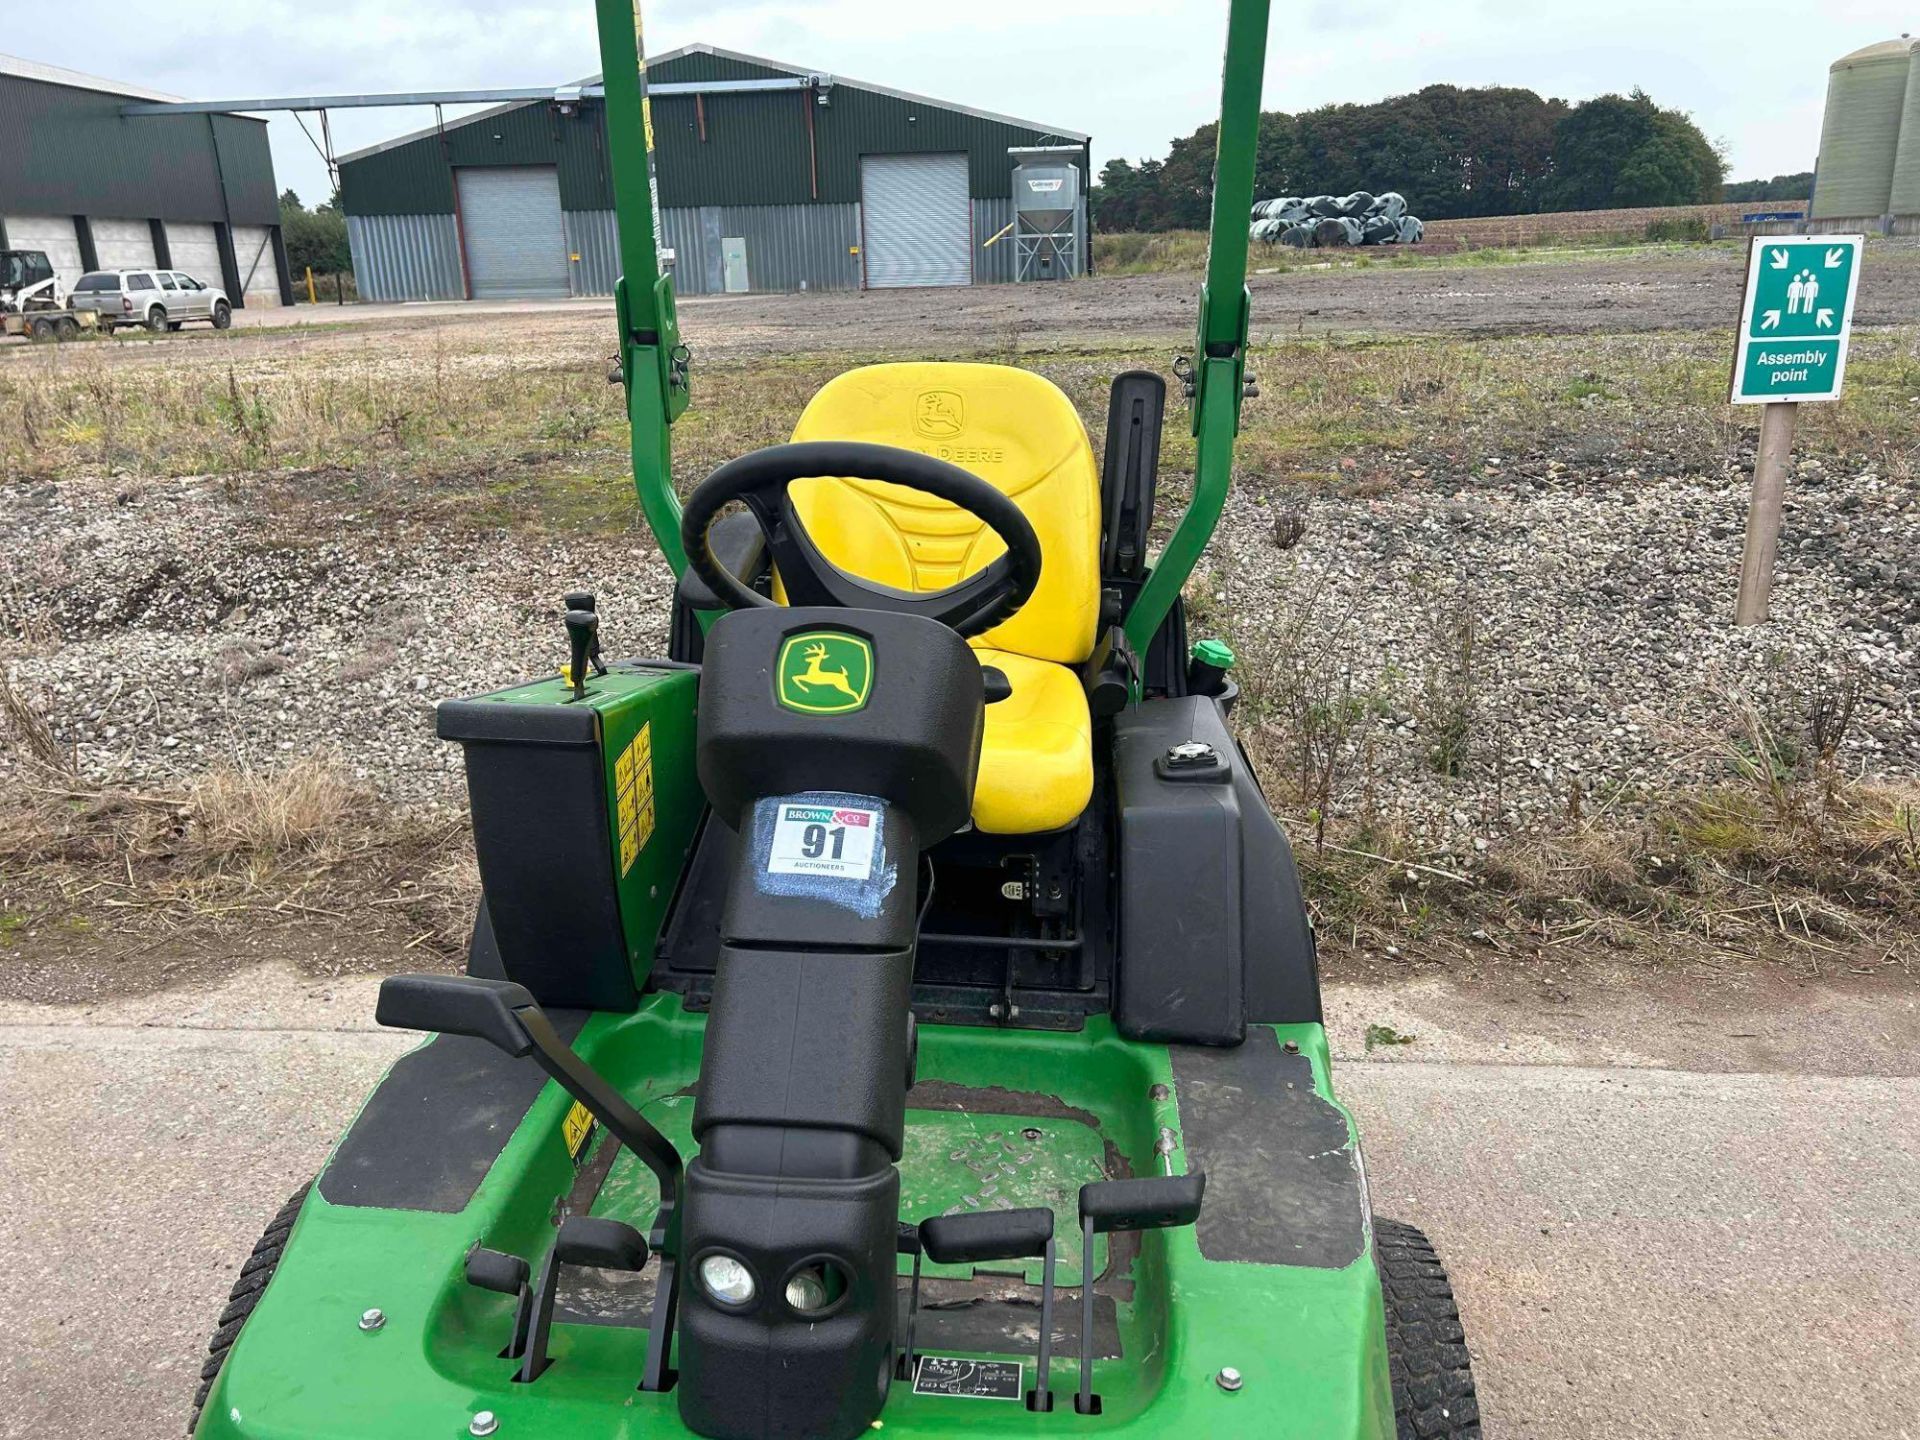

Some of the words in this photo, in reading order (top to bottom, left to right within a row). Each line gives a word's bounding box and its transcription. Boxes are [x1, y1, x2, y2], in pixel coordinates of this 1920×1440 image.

[1757, 350, 1827, 366] Assembly
[1770, 368, 1808, 385] point
[937, 444, 1003, 463] DEERE
[802, 824, 846, 860] 91
[794, 861, 845, 872] AUCTIONEERS
